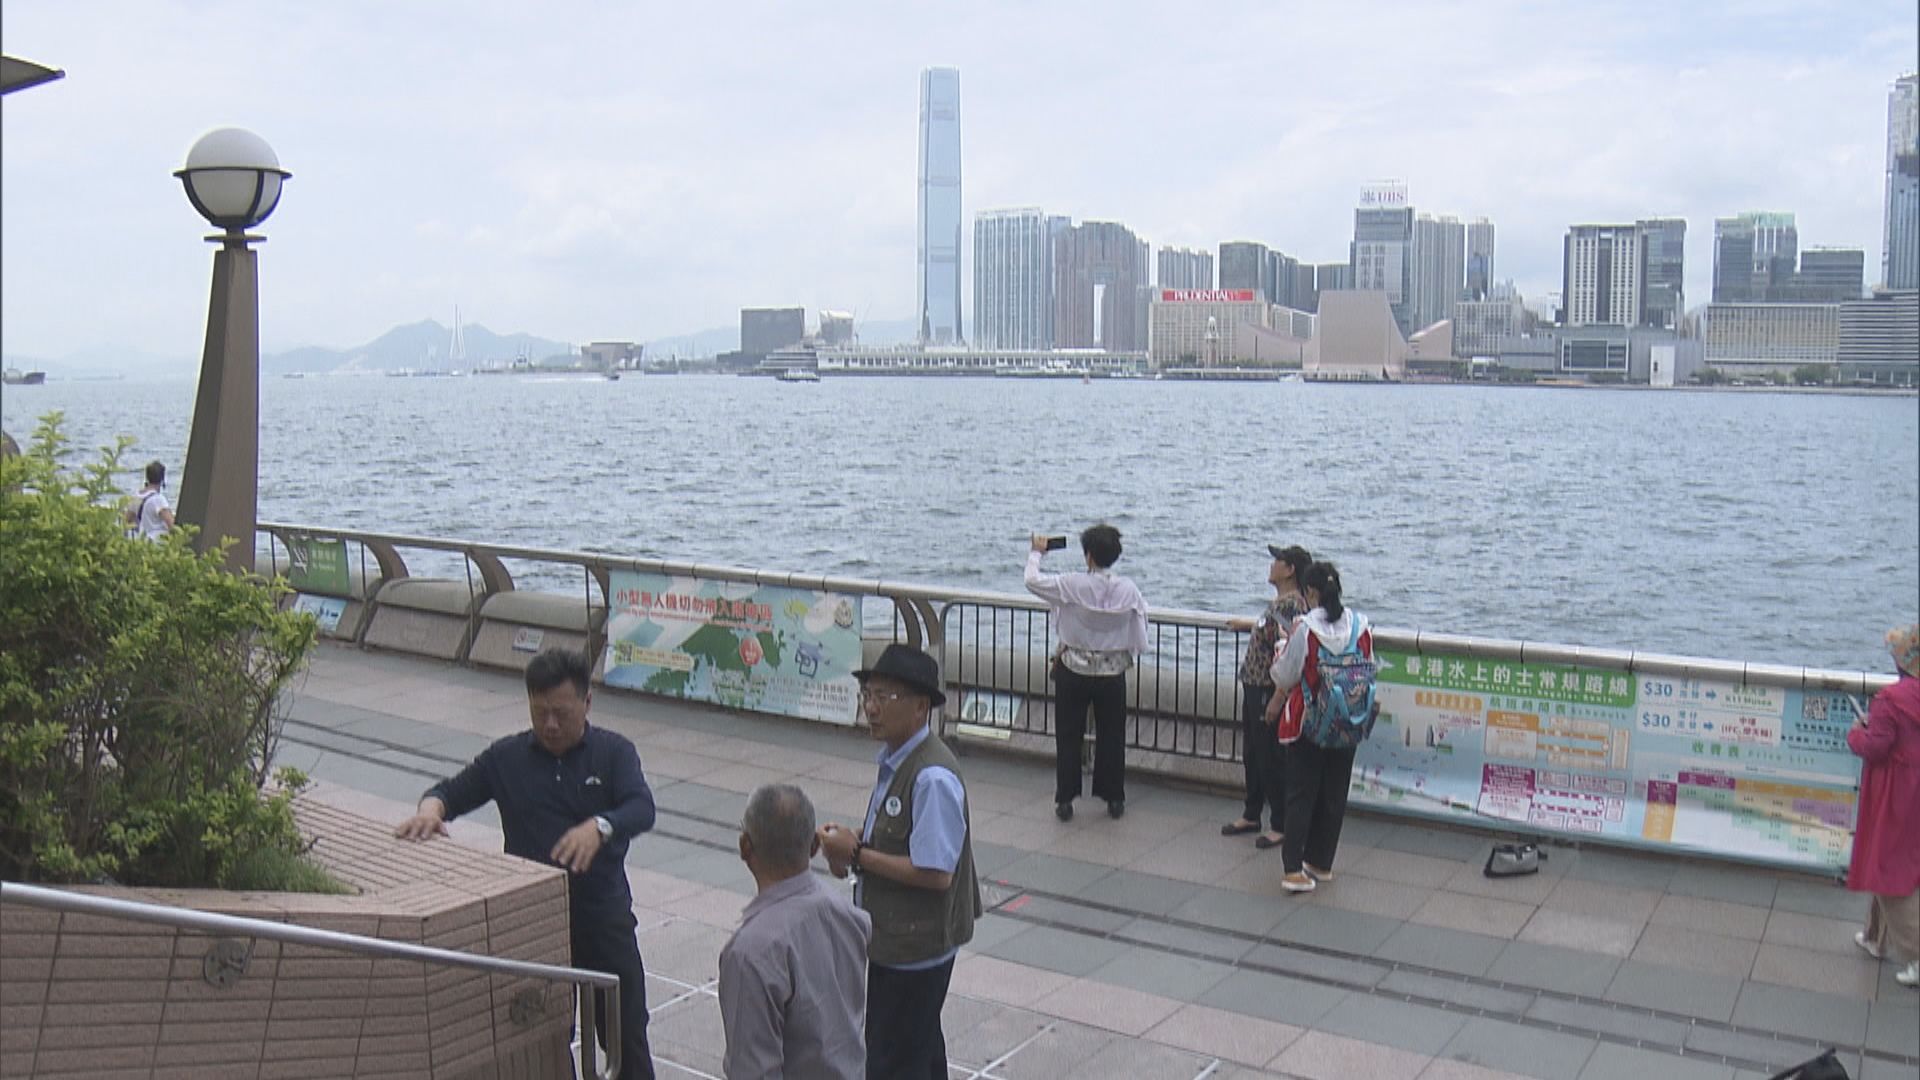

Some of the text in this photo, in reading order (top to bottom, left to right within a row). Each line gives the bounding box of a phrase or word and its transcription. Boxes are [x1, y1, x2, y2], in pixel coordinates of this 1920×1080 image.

[1174, 289, 1230, 301] PRUDENTIAL
[1405, 656, 1629, 696] 香港水上的士常規路線
[1644, 680, 1673, 698] $30
[1642, 712, 1671, 728] $30
